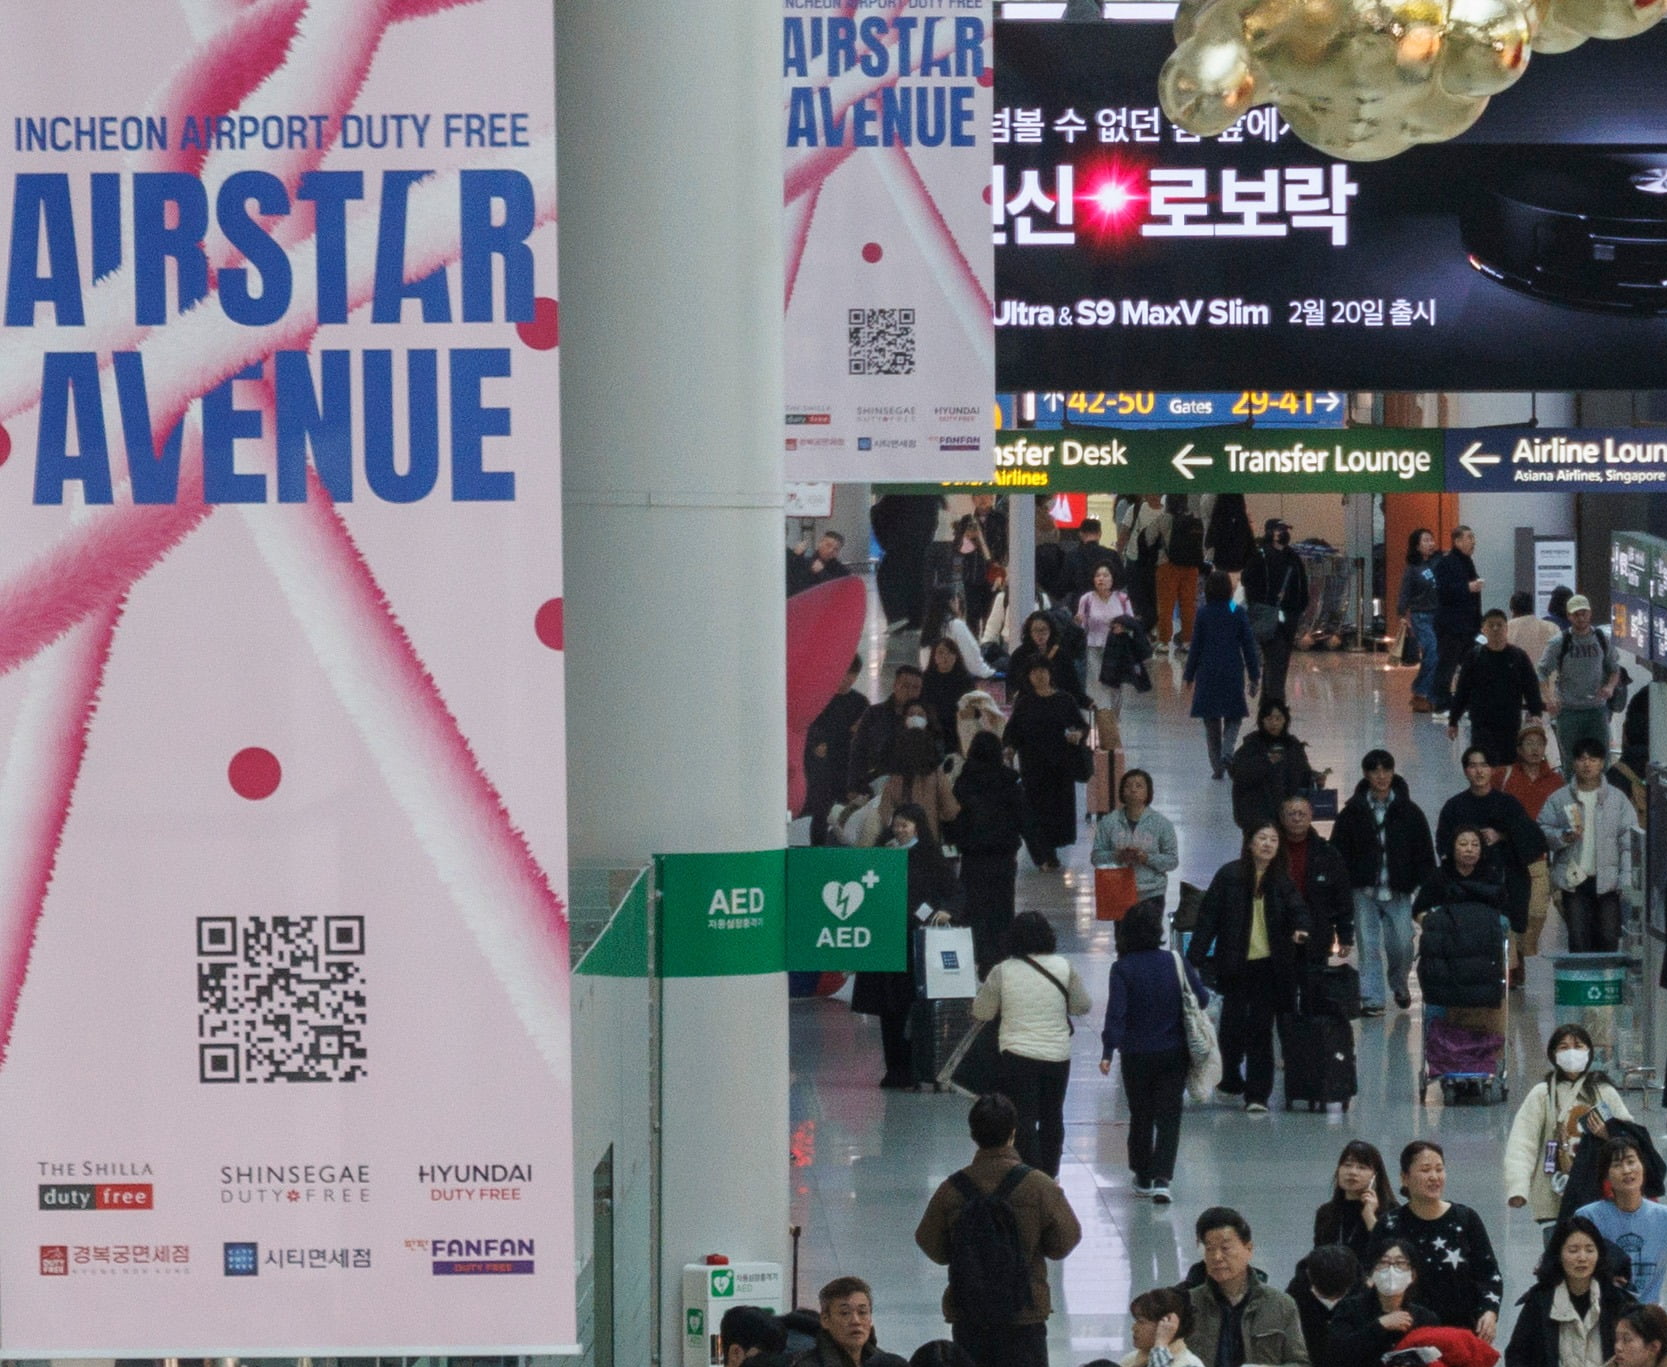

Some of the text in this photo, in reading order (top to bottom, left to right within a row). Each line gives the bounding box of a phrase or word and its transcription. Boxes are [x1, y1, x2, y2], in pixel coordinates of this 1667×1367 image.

[783, 0, 841, 9] NCHEON
[784, 16, 985, 78] AIRSTAR
[786, 86, 976, 148] AVENUE
[1053, 108, 1087, 143] 수
[1096, 107, 1161, 143] 없던
[14, 112, 531, 152] INCHEON AIRPORT DUTY FREE
[1140, 163, 1359, 246] 로보락
[3, 168, 537, 328] AIRSTAR
[1058, 306, 1074, 326] &
[1077, 299, 1116, 327] S9
[1121, 300, 1205, 327] MaxV
[1208, 299, 1269, 327] Slim
[1288, 299, 1326, 326] 2월
[1330, 299, 1385, 326] 20일
[1388, 298, 1437, 327] 출시
[1068, 391, 1154, 415] 42-50
[1169, 398, 1213, 416] Gates
[31, 347, 517, 506] AVENUE
[1061, 438, 1129, 467] Desk
[1225, 443, 1432, 480] Transfer Lounge
[1512, 437, 1600, 465] Airline
[1514, 469, 1553, 482] Asiana
[1555, 469, 1604, 484] Airlines,
[1606, 469, 1666, 486] Singapore
[708, 888, 764, 915] AED
[816, 926, 871, 949] AED
[37, 1160, 154, 1177] THE SHILLA
[220, 1165, 371, 1185] SHINSEGAE
[418, 1164, 533, 1184] HYUNDAI
[43, 1188, 147, 1209] duty free
[220, 1188, 371, 1204] DUTY FREE
[430, 1188, 522, 1201] DUTY FREE
[72, 1244, 190, 1265] 경복궁면세점
[264, 1248, 372, 1270] 시티면세점
[431, 1238, 535, 1257] FANFAN
